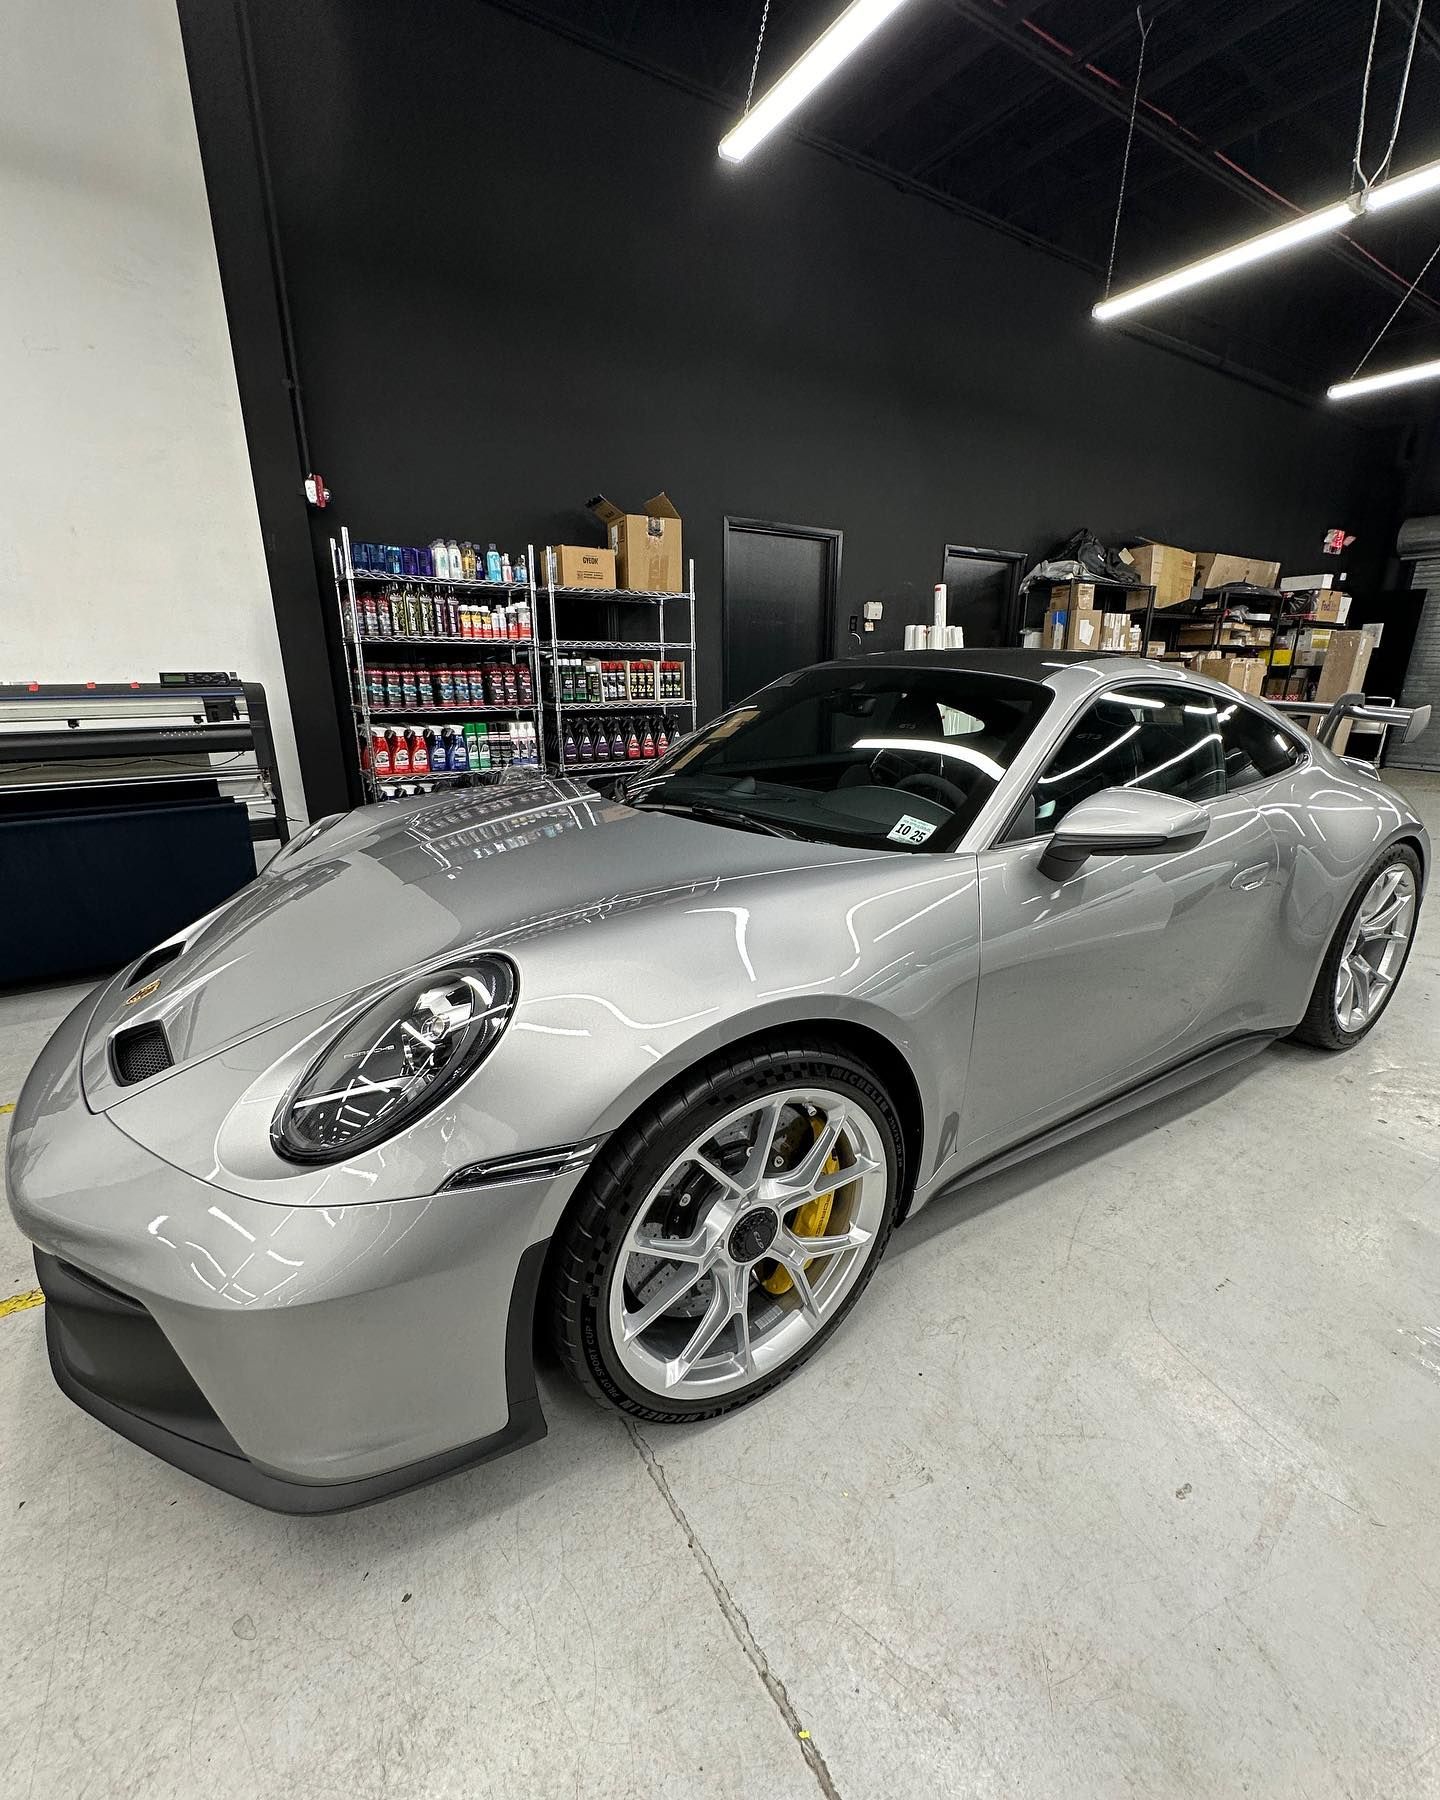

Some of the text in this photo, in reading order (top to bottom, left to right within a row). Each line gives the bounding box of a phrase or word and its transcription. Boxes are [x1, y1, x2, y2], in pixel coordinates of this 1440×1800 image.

[895, 823, 911, 836] 10
[909, 830, 926, 843] 25
[830, 1066, 889, 1112] MICHELIN
[585, 1325, 594, 1345] CUP
[589, 1349, 605, 1377] SPORT
[600, 1379, 620, 1398] PILOT
[619, 1399, 701, 1424] MICHELIN
